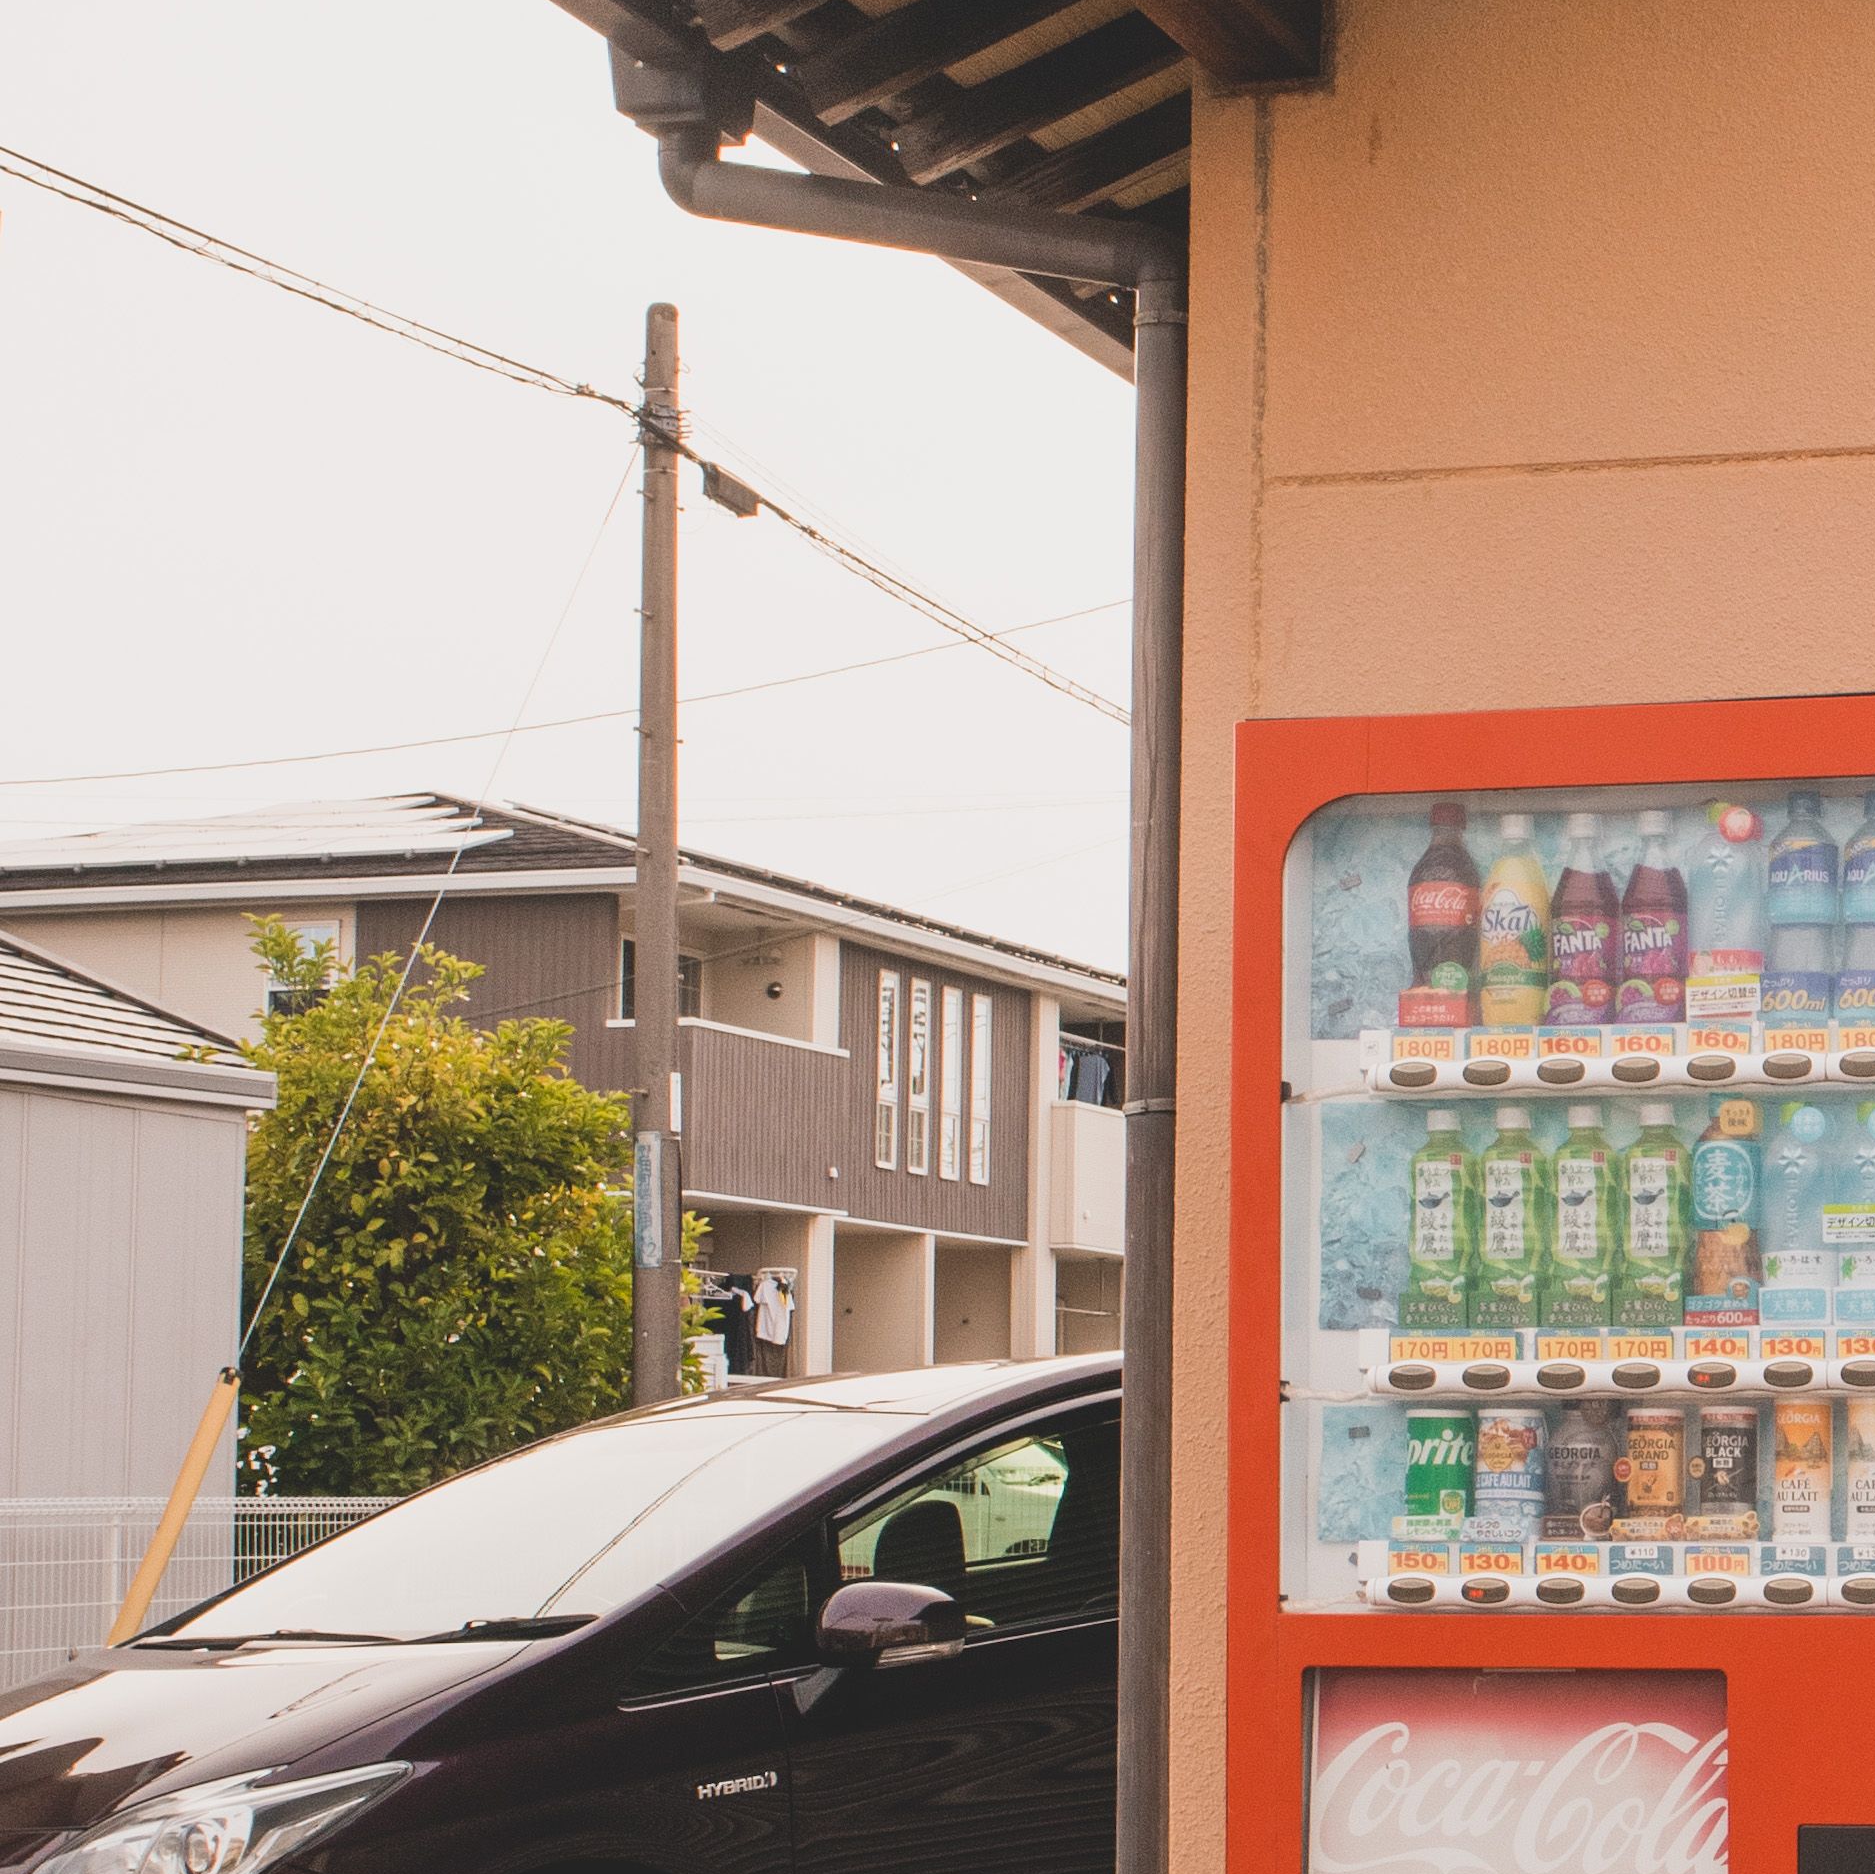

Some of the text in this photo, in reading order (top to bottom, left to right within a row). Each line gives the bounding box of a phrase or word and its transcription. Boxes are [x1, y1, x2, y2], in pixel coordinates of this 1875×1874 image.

[1553, 930, 1602, 956] FANTA
[1624, 927, 1673, 953] FANTA
[1397, 1039, 1450, 1059] 180円
[1476, 1038, 1529, 1056] 180円
[1542, 1037, 1598, 1054] 160円
[1615, 1036, 1670, 1053] 160円
[1692, 1031, 1746, 1050] 160円
[1769, 1033, 1825, 1051] 180円
[1703, 1149, 1734, 1213] 麦茶
[1396, 1342, 1448, 1359] 170円
[1459, 1342, 1512, 1358] 170円
[1545, 1341, 1596, 1358] 170円
[1614, 1340, 1667, 1357] 170円
[1690, 1338, 1745, 1356] 140円
[1765, 1338, 1821, 1355] 130円
[1407, 1429, 1473, 1466] prite
[1632, 1450, 1669, 1460] GRAND
[1706, 1447, 1741, 1458] BLACK
[1781, 1478, 1811, 1490] CAFÉ
[1791, 1491, 1819, 1502] LAIT
[1469, 1520, 1499, 1530] ミルクの
[1476, 1529, 1522, 1538] やさしいコク
[1391, 1552, 1446, 1570] 150円
[1630, 1548, 1654, 1557] ¥110
[1781, 1548, 1807, 1558] ¥130
[1463, 1554, 1519, 1570] 130円
[1542, 1555, 1596, 1571] 140円
[1689, 1555, 1744, 1572] 100円
[697, 1775, 766, 1800] HYBRID
